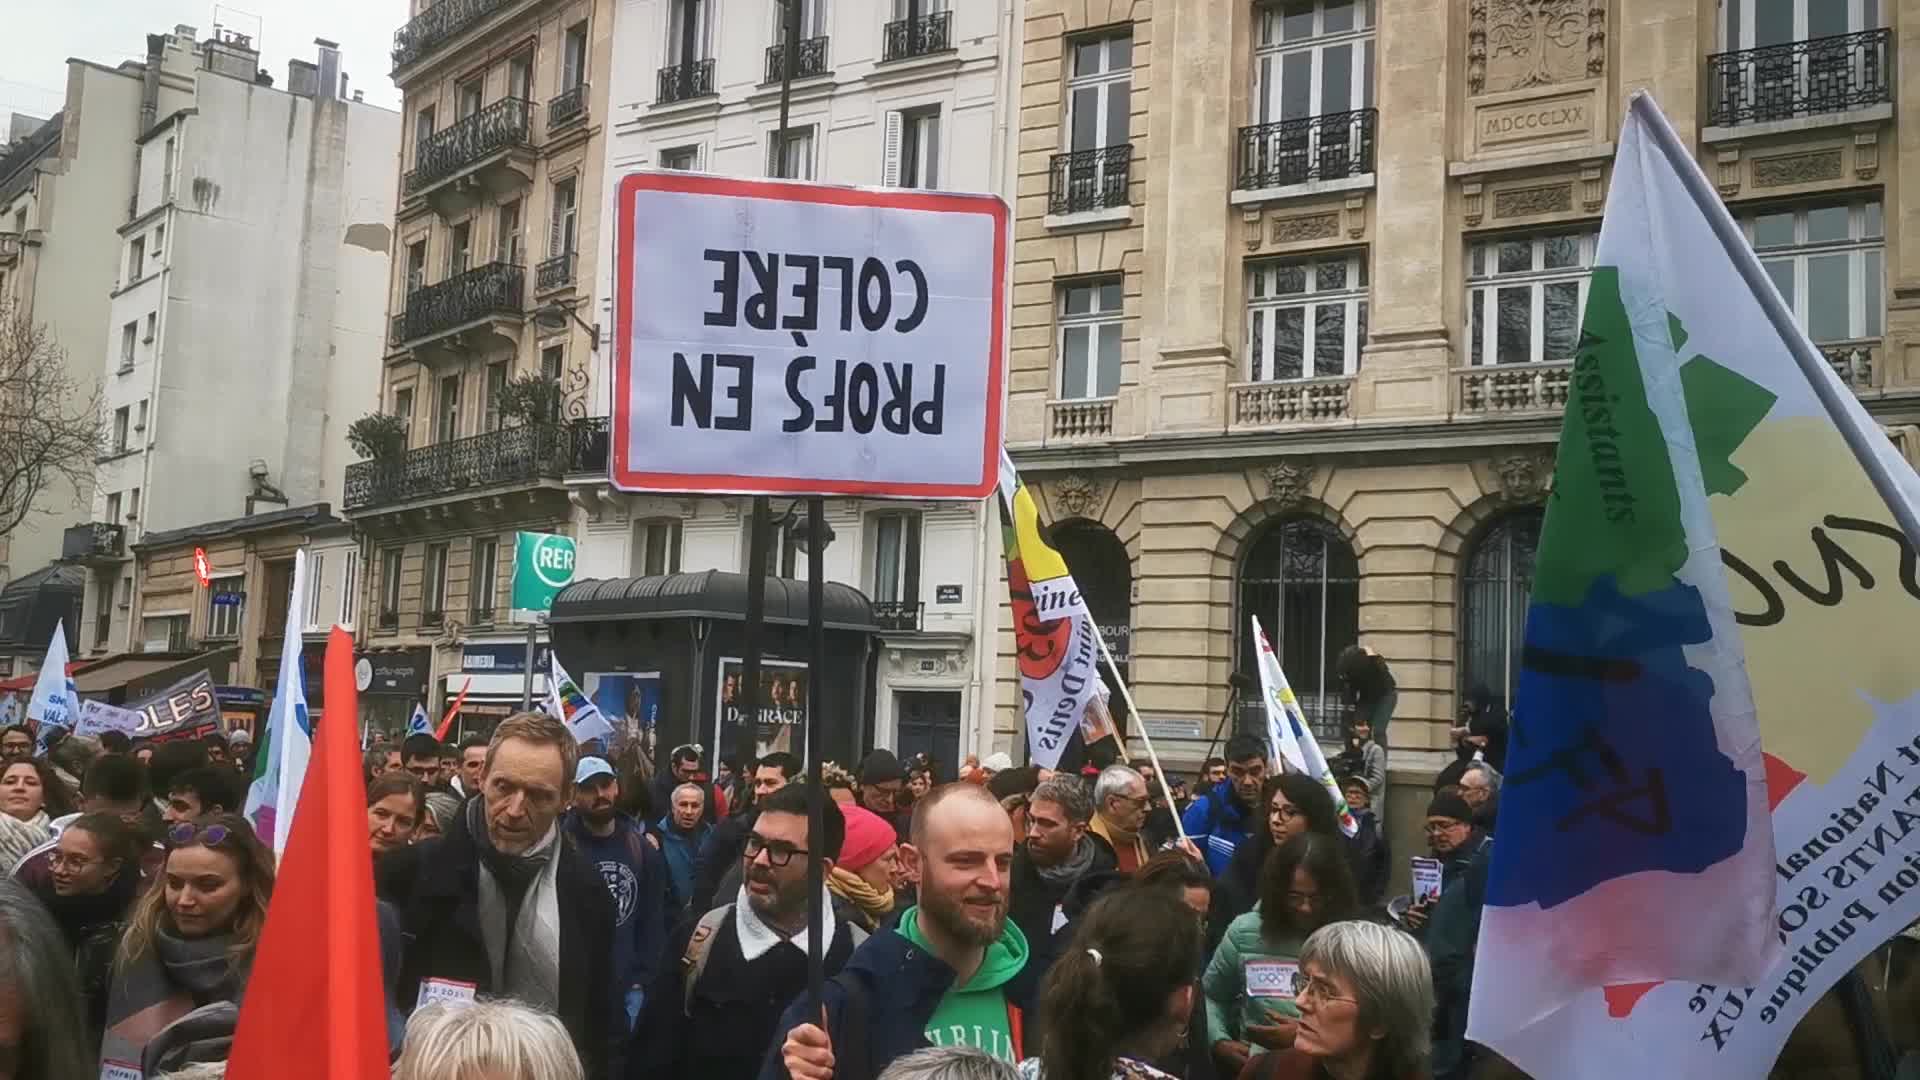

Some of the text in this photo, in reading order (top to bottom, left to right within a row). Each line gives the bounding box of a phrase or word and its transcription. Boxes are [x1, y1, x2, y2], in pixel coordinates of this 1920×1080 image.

[703, 248, 929, 348] COLÈRE
[670, 352, 946, 435] PROFS EN
[1575, 329, 1639, 524] Assistants
[539, 547, 574, 570] RER
